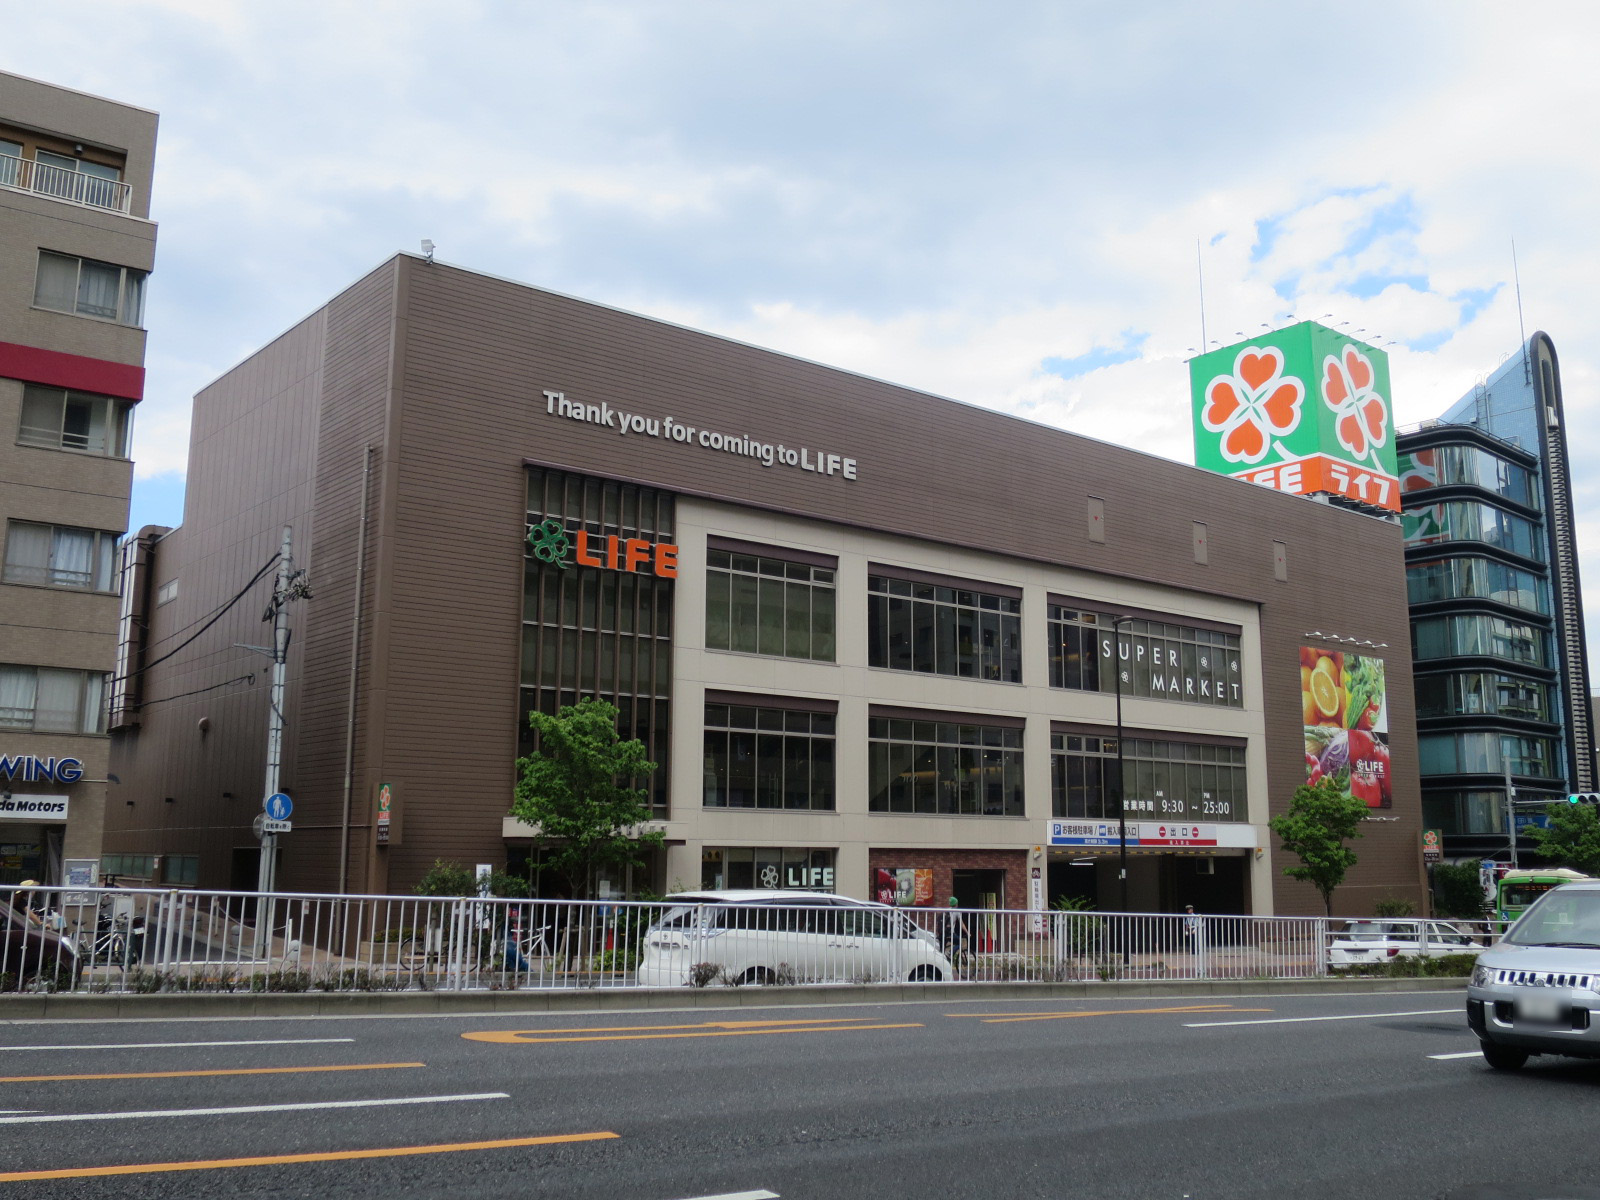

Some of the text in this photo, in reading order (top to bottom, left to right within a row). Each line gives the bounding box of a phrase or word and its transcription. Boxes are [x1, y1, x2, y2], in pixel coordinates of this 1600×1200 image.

[542, 390, 857, 480] Thank you for coming to LIFE
[1330, 463, 1390, 505] ライフ
[576, 530, 679, 578] LIFE
[1102, 639, 1178, 667] SUPER
[1152, 673, 1239, 700] MARKET
[1364, 760, 1384, 772] LIFE
[16, 800, 65, 812] Motors
[1161, 799, 1184, 813] 9:30
[1203, 801, 1230, 814] 25:00
[1170, 826, 1188, 836] 出口
[788, 867, 834, 886] LIFE
[889, 890, 907, 899] LIFE
